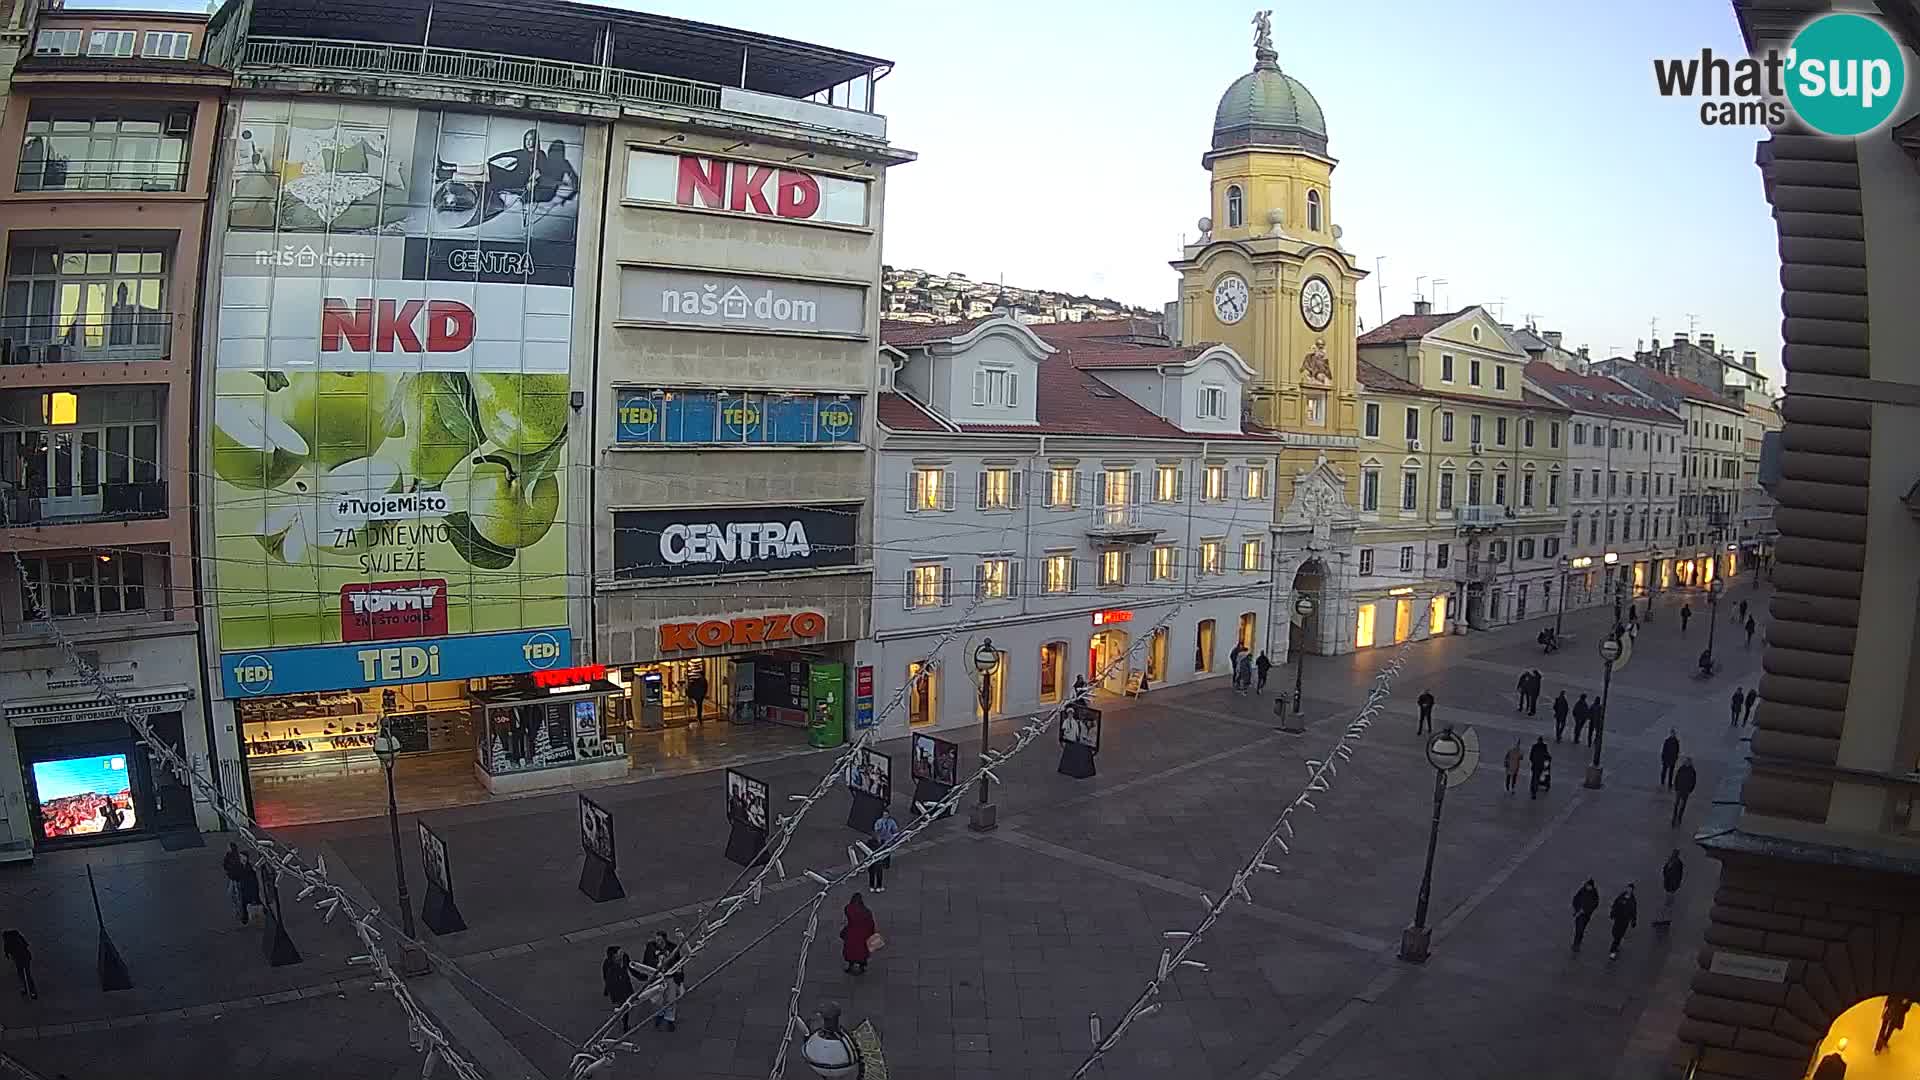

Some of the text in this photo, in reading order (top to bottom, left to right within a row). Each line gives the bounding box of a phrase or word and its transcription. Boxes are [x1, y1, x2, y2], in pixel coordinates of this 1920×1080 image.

[676, 155, 820, 219] NKD
[255, 243, 367, 269] naš dom
[448, 248, 535, 276] CENTRA
[661, 283, 816, 323] naš dom
[320, 296, 478, 354] NKD
[619, 407, 658, 425] TEDi
[723, 409, 760, 426] TEDi
[820, 411, 853, 427] TEDi
[337, 495, 447, 517] #TvojeMisto
[333, 522, 451, 549] ZA DNEVNO
[659, 520, 812, 565] CENTRA
[359, 547, 426, 575] SVJEŽE
[348, 586, 439, 614] TOMMY
[659, 612, 826, 652] KORZO
[357, 645, 441, 683] TEDi
[523, 643, 560, 660] TEDi
[233, 664, 274, 684] TEDi
